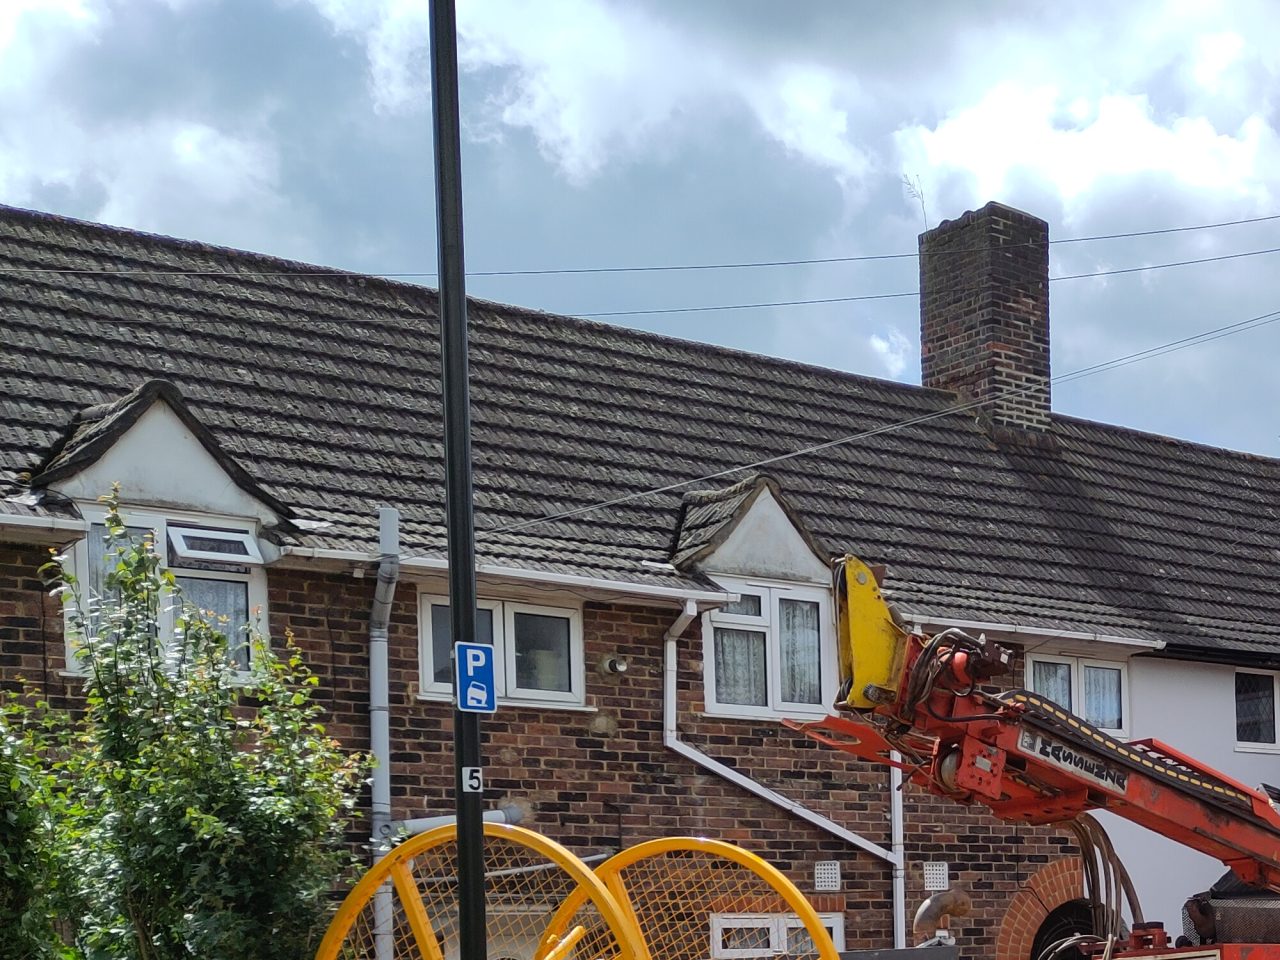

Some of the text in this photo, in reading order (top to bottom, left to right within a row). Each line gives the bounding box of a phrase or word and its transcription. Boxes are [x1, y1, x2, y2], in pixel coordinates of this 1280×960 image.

[466, 649, 486, 677] P
[1039, 736, 1126, 790] MASSENZA
[468, 769, 481, 791] 5
